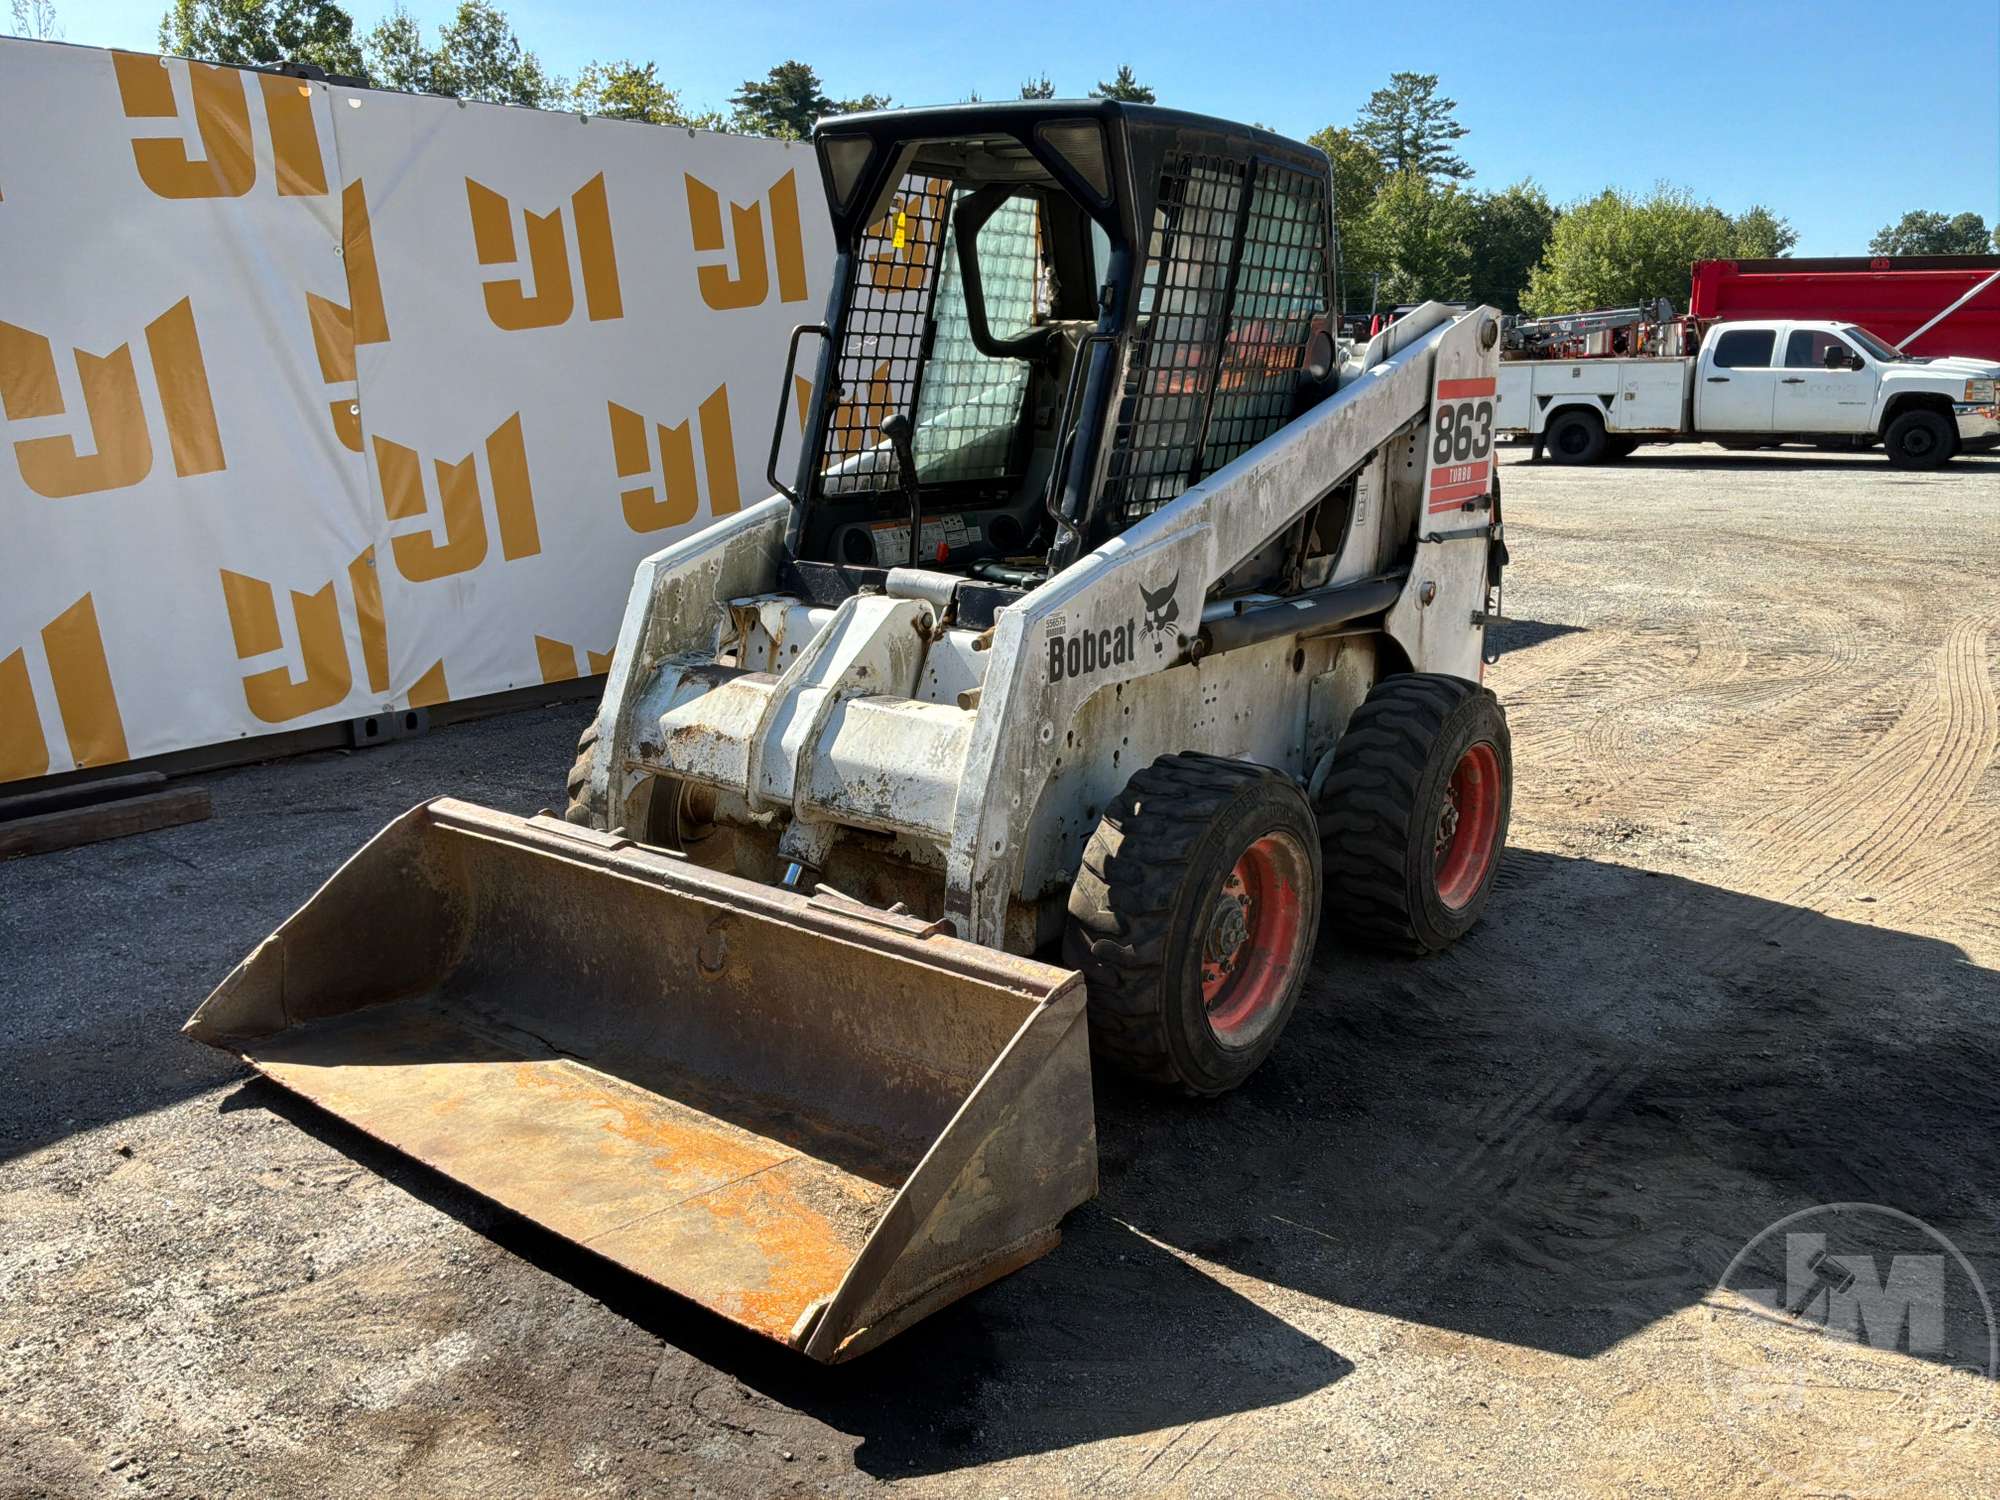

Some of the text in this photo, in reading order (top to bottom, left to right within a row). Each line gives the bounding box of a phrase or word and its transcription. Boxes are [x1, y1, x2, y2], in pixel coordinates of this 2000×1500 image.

[1432, 401, 1493, 465] 863
[1449, 466, 1472, 483] TURBO
[1049, 617, 1136, 684] Bobcat
